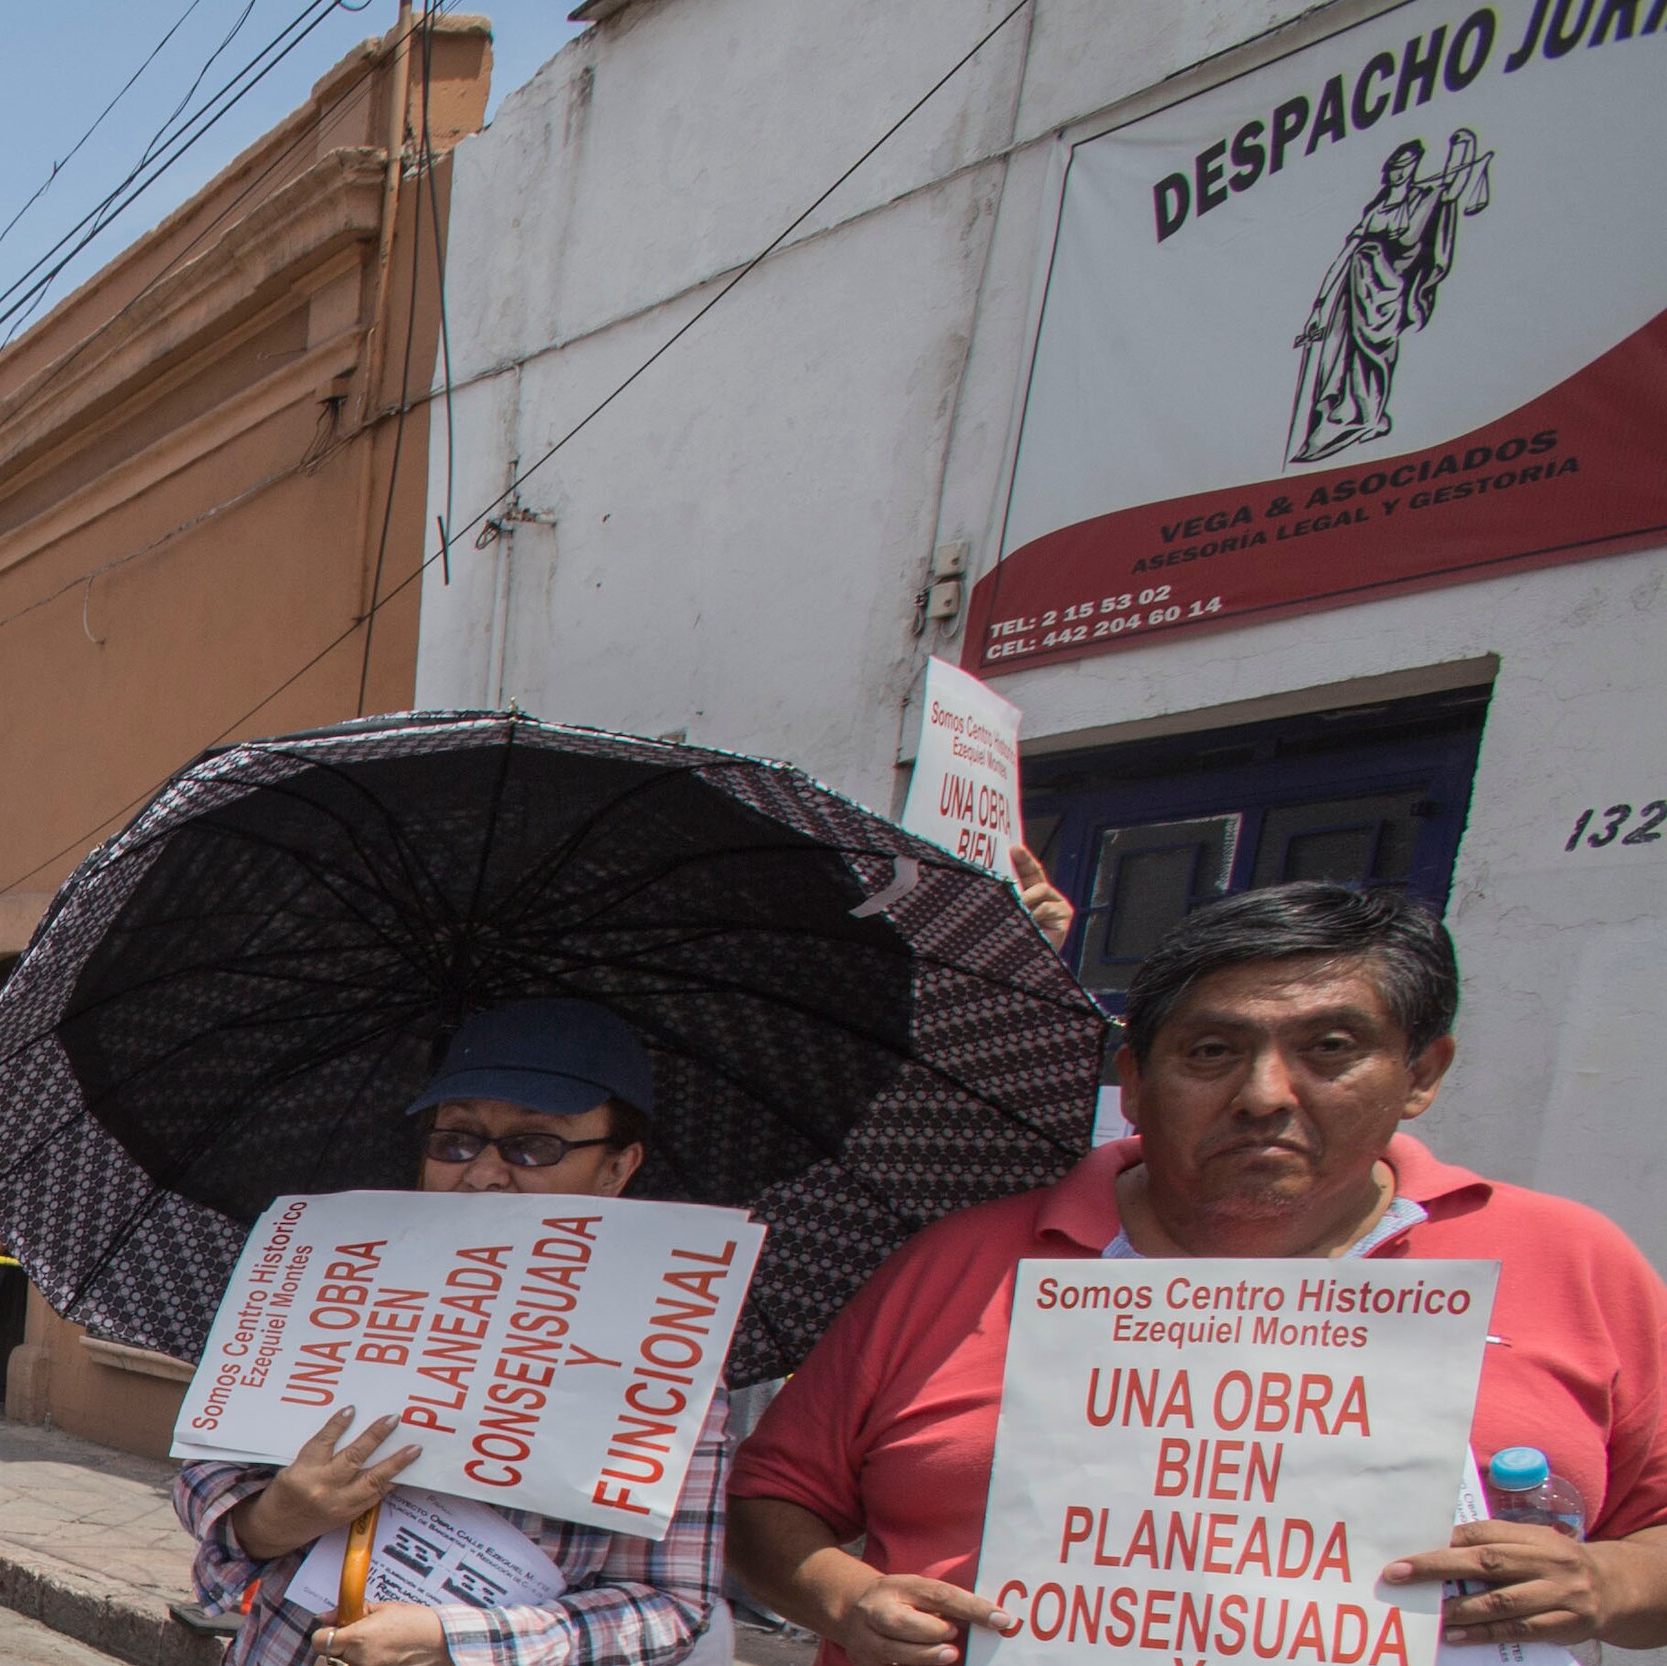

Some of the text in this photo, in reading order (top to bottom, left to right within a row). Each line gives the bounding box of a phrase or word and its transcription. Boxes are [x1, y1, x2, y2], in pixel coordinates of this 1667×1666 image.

[1153, 6, 1497, 245] DESPACHO
[1131, 457, 1581, 575] ASESORÍA LEGAL Y GESTORÍA
[1159, 429, 1560, 545] VEGA & ASOCIADOS
[986, 597, 1223, 660] CEL: 442 204 60 14
[990, 585, 1172, 639] TEL: 2 15 53 02
[931, 700, 964, 733] Somos
[940, 772, 974, 824] UNA
[1565, 799, 1667, 852] 132
[192, 1201, 308, 1431] Somos Centro Historico
[240, 1244, 314, 1388] Ezequiel Montes
[281, 1239, 388, 1407] UNA OBRA
[356, 1288, 430, 1367] BIEN
[1037, 1278, 1471, 1316] Somos Centro Historico
[1112, 1315, 1369, 1349] Ezequiel Montes
[400, 1245, 514, 1434] PLANEADA
[464, 1215, 603, 1487] CONSENSUADA
[564, 1344, 622, 1368] Y
[591, 1240, 738, 1515] FUNCIONAL
[1086, 1367, 1372, 1437] UNA OBRA
[1154, 1438, 1283, 1503] BIEN
[1060, 1506, 1352, 1583] PLANEADA
